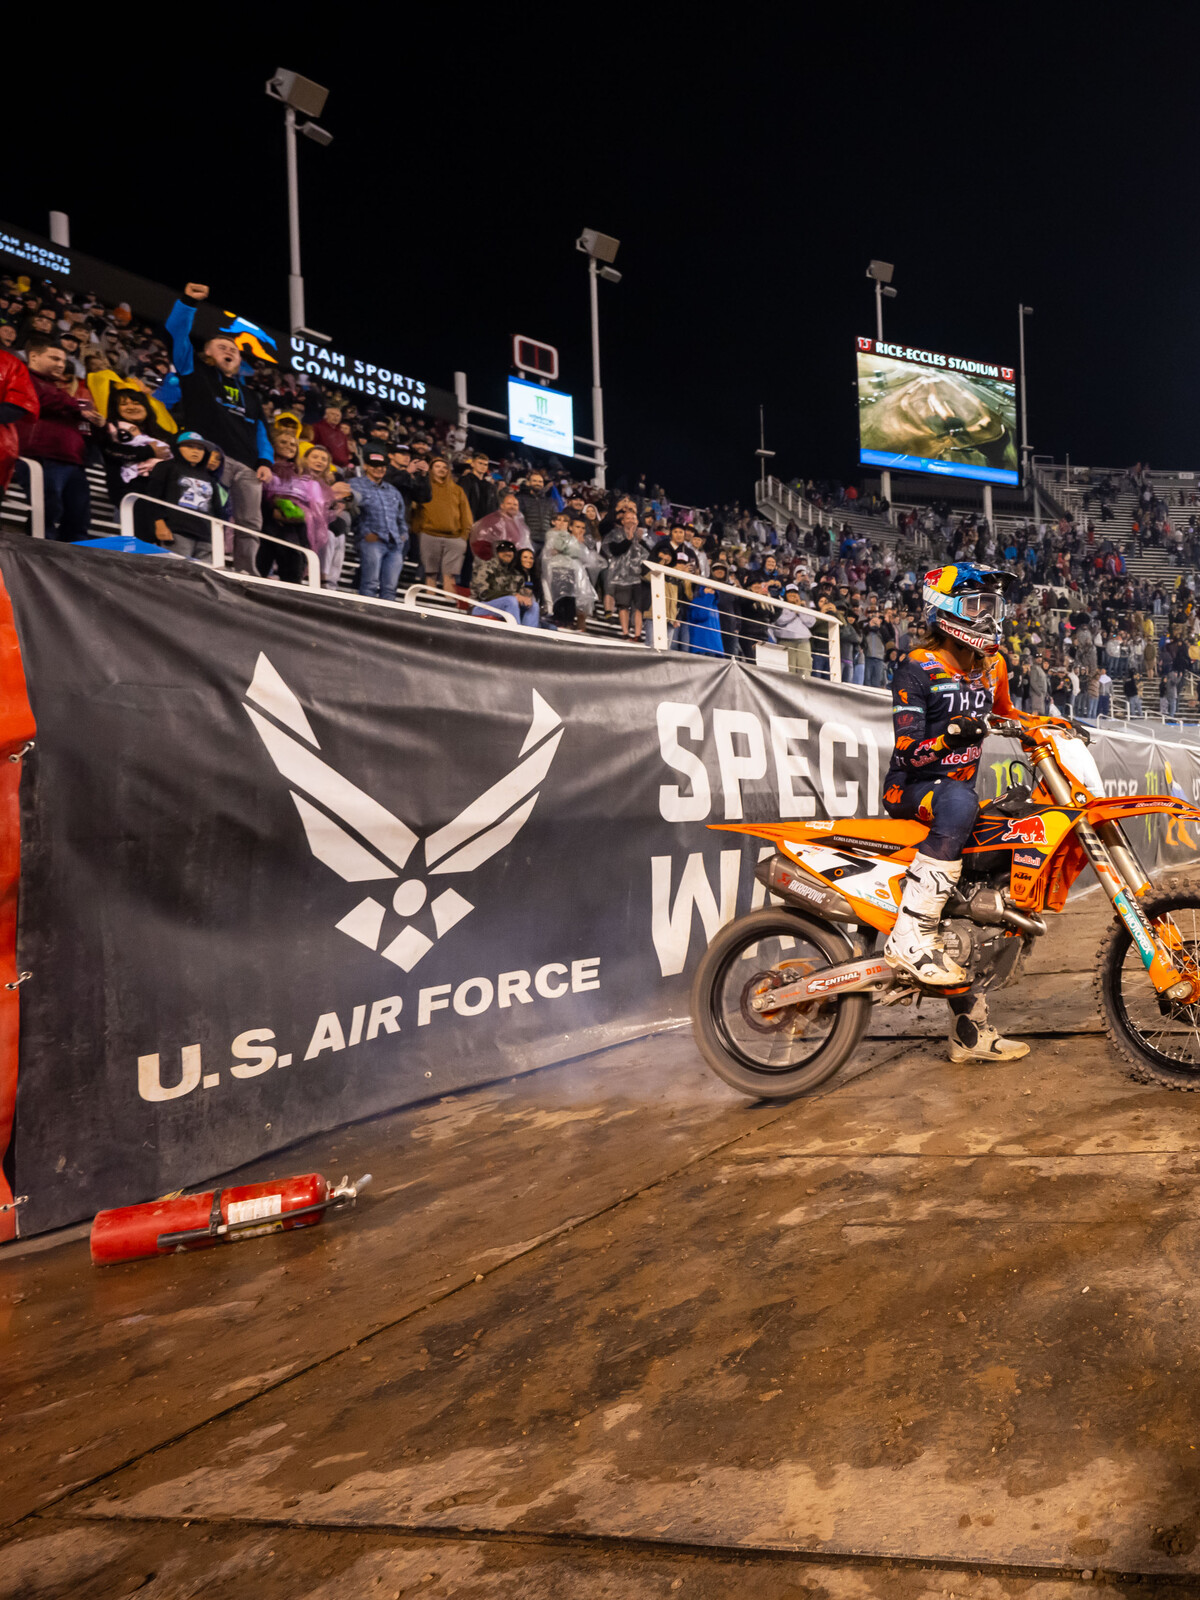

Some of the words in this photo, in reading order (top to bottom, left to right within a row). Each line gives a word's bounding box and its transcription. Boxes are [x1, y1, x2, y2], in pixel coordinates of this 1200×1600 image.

[24, 242, 71, 266] SPORTS
[290, 336, 345, 367] UTAH
[353, 359, 426, 394] SPORTS
[875, 341, 947, 367] RICE-ECCLES
[948, 357, 999, 378] STADIUM
[290, 355, 426, 411] COMMISSION
[859, 839, 882, 848] UNIVERSITY
[1013, 871, 1033, 881] KTM
[1124, 912, 1154, 956] MOTOREX
[807, 971, 860, 994] RENTHAL
[138, 1028, 292, 1102] U.S.
[303, 995, 403, 1061] AIR
[417, 957, 600, 1026] FORCE
